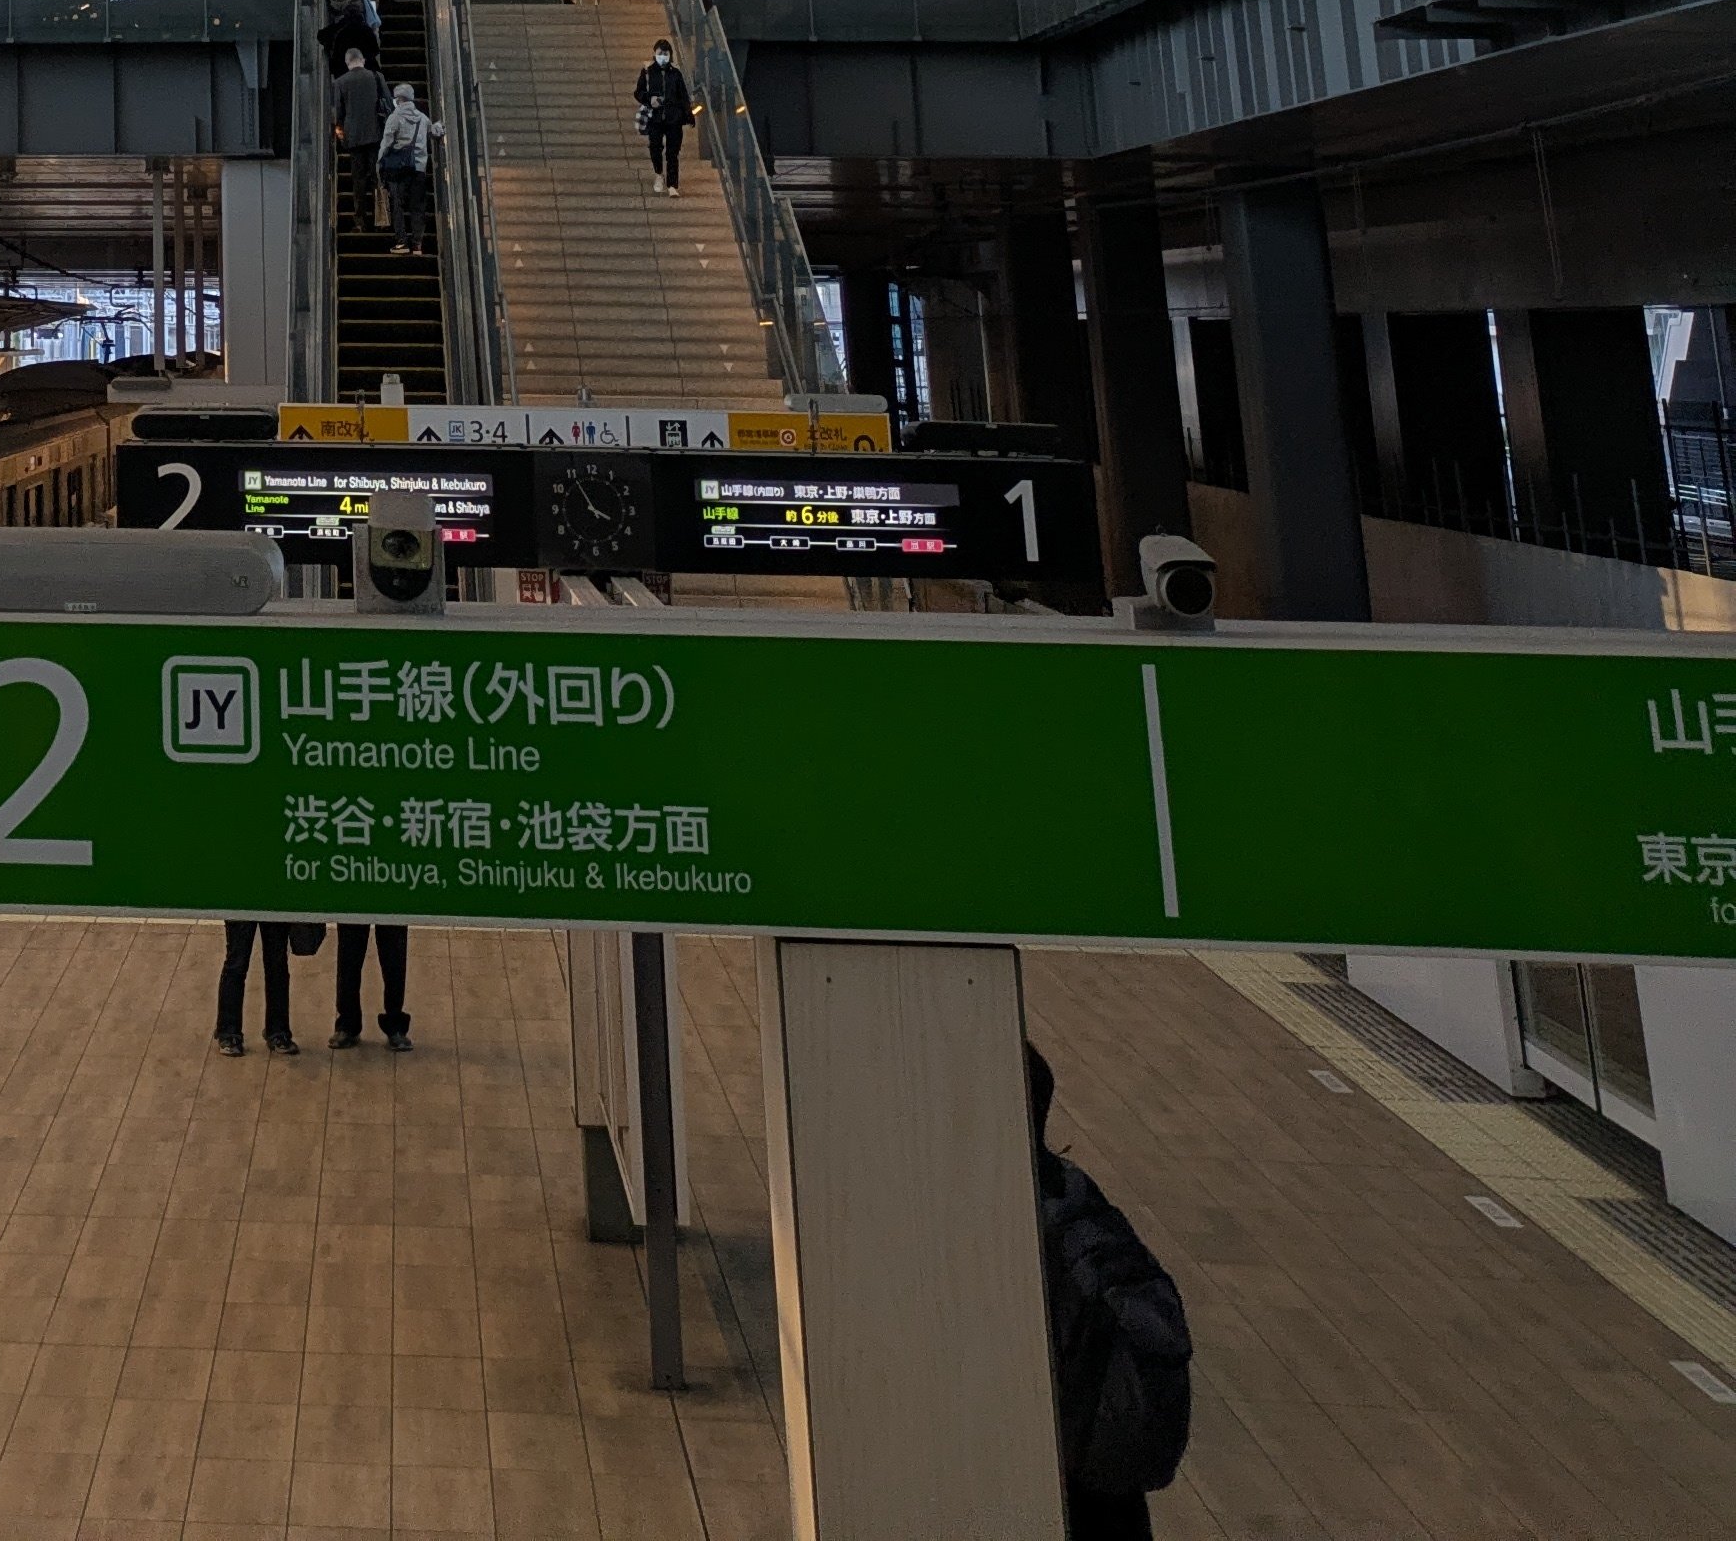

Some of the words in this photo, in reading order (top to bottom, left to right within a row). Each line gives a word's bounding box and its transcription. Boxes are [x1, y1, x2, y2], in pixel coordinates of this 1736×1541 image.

[566, 468, 577, 479] 11
[586, 464, 598, 475] 12
[608, 469, 615, 481] 1
[265, 474, 306, 487] Yamanote
[307, 475, 327, 488] Line
[334, 476, 347, 488] for
[349, 477, 389, 492] Shibuya,
[391, 478, 430, 492] Shinjuku
[432, 479, 440, 490] &
[441, 480, 487, 492] Ikebukuro
[552, 483, 565, 494] 10
[623, 485, 630, 496] 2
[157, 463, 202, 531] 2
[245, 494, 289, 505] Yamanote
[245, 504, 265, 514] Line
[339, 496, 352, 514] 4
[448, 501, 455, 514] &
[456, 501, 490, 517] Shibuya
[551, 504, 560, 515] 9
[628, 505, 637, 516] 3
[1004, 479, 1039, 563] 1
[557, 524, 565, 535] 8
[624, 525, 632, 536] 4
[573, 540, 580, 550] 7
[611, 541, 619, 552] 5
[592, 545, 600, 557] 6
[521, 572, 543, 583] STOP
[185, 689, 237, 730] JY
[279, 658, 676, 729] 山手線(外回り)
[281, 732, 455, 769] Yamanote
[468, 736, 542, 771] Line
[283, 794, 710, 856] 渋谷・新宿・池袋方面
[285, 854, 320, 882] for
[329, 855, 448, 891] Shibuya,
[458, 858, 576, 894] Shinjuku
[585, 862, 606, 890] &
[615, 863, 753, 894] Ikebukuro
